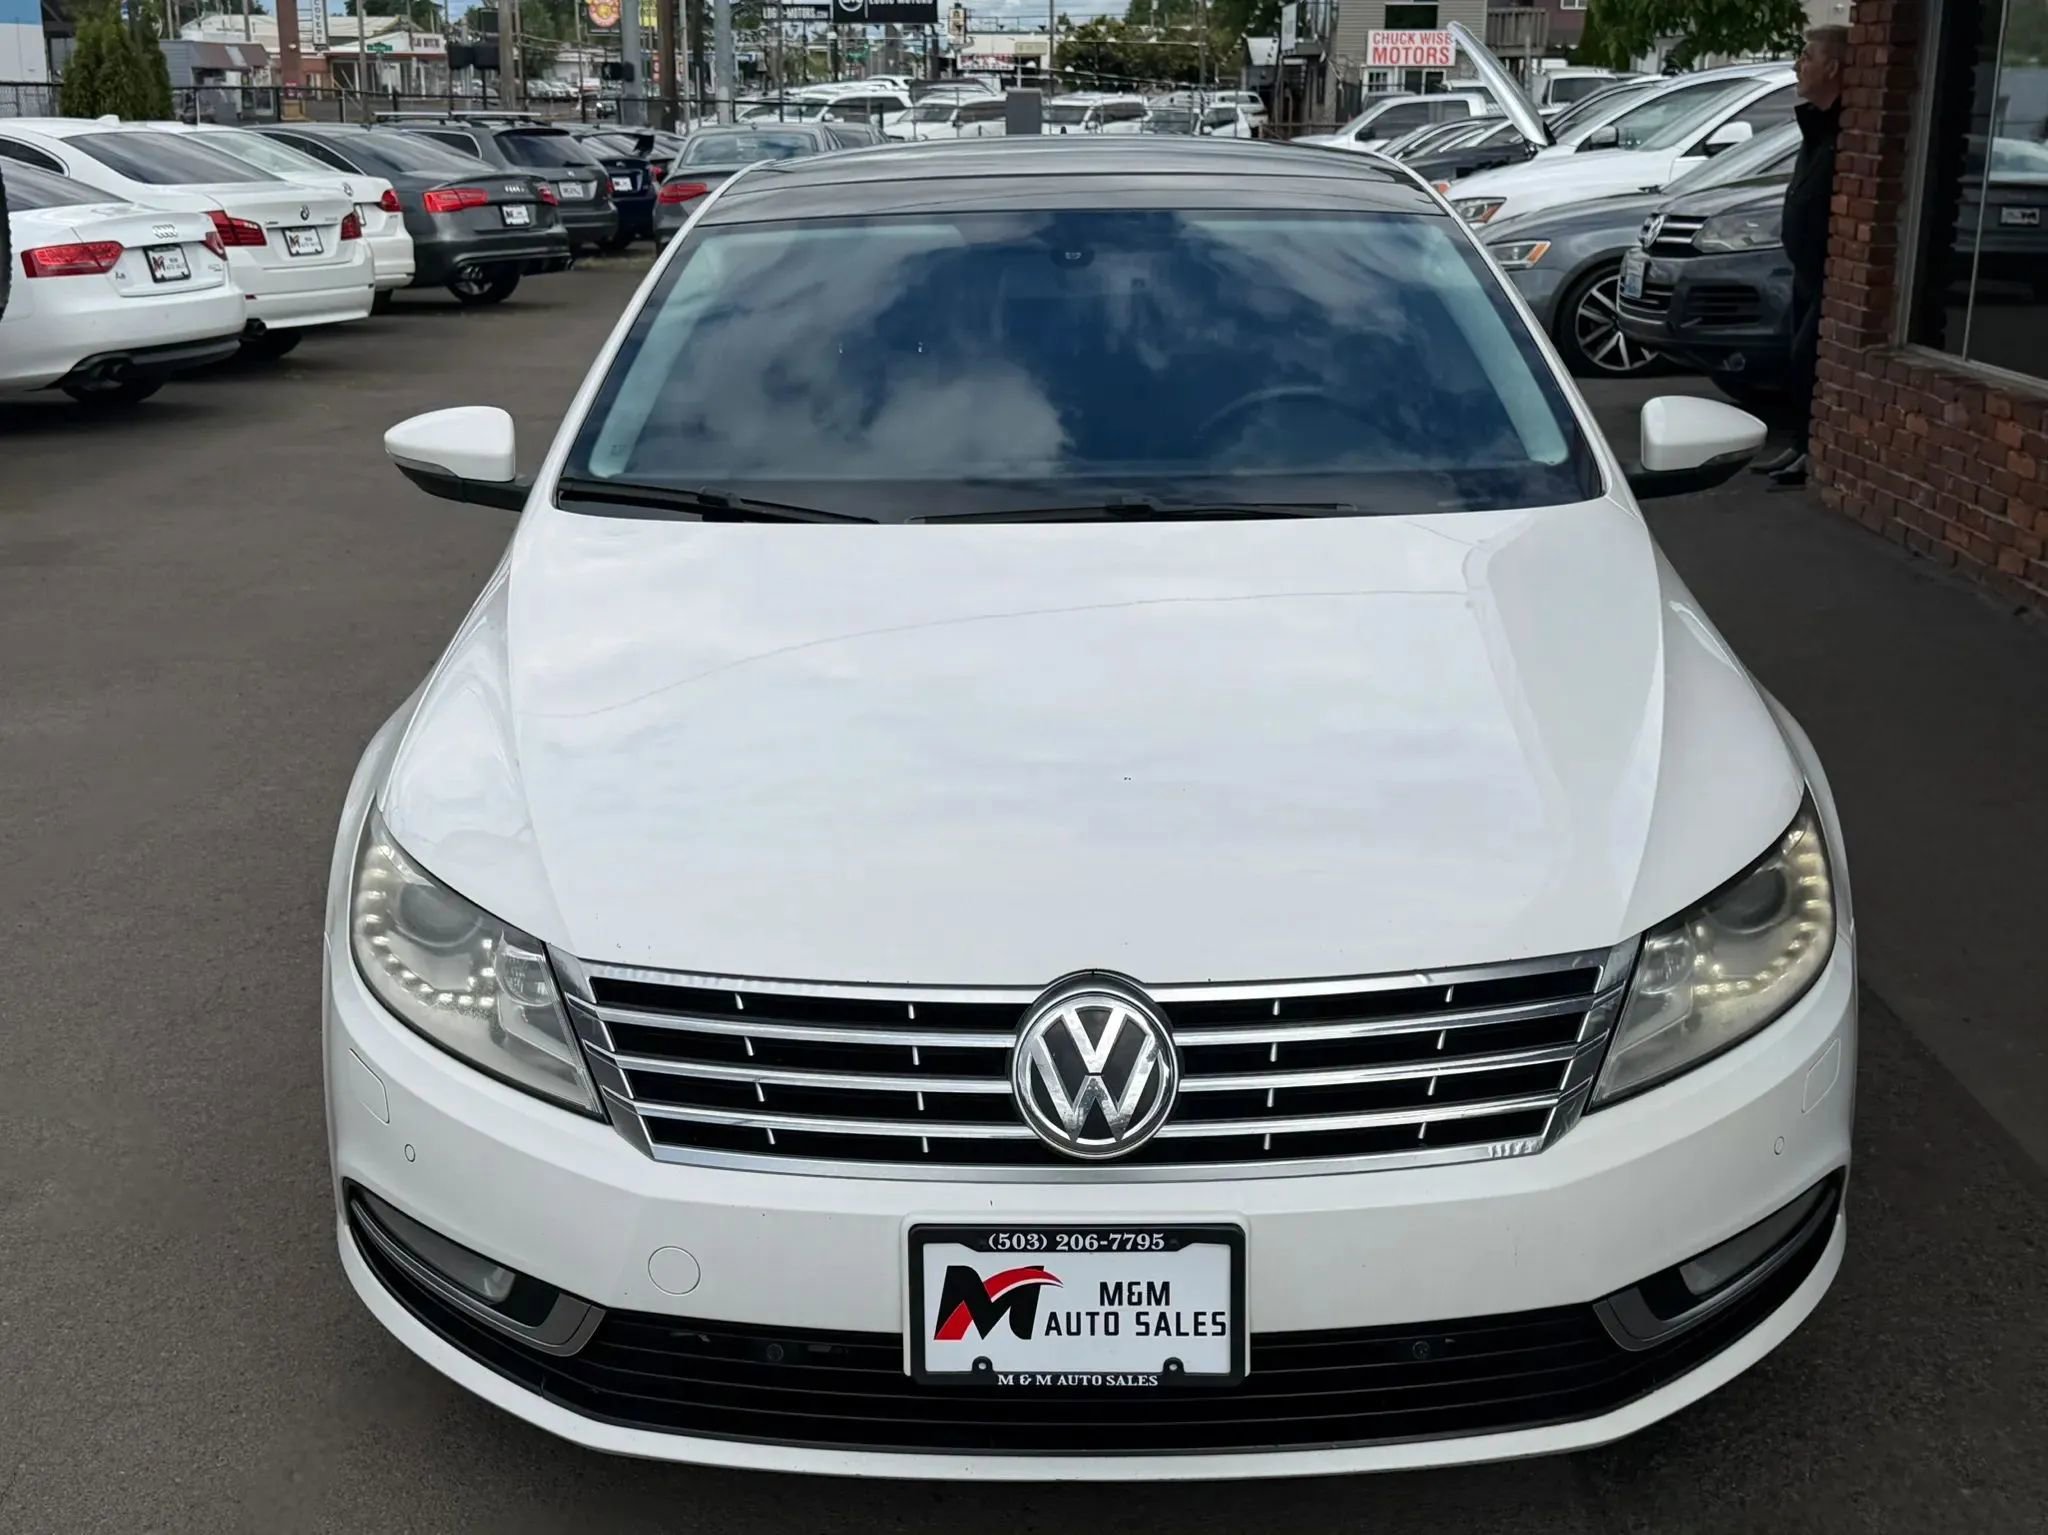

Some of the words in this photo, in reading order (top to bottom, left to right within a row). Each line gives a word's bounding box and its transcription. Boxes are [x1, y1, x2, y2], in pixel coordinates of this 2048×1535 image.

[1373, 32, 1415, 45] CHUCK
[1421, 32, 1453, 45] WISE
[1373, 47, 1449, 64] MOTORS
[988, 1233, 1047, 1250] (503)
[1055, 1233, 1165, 1251] 206-7795
[1100, 1281, 1170, 1306] M&M
[1044, 1311, 1120, 1336] AUTO
[1135, 1311, 1227, 1336] SALES
[998, 1374, 1014, 1385] M
[1020, 1374, 1031, 1385] &
[1036, 1374, 1052, 1385] M
[1058, 1375, 1102, 1385] AUTO
[1106, 1375, 1158, 1386] SALES
